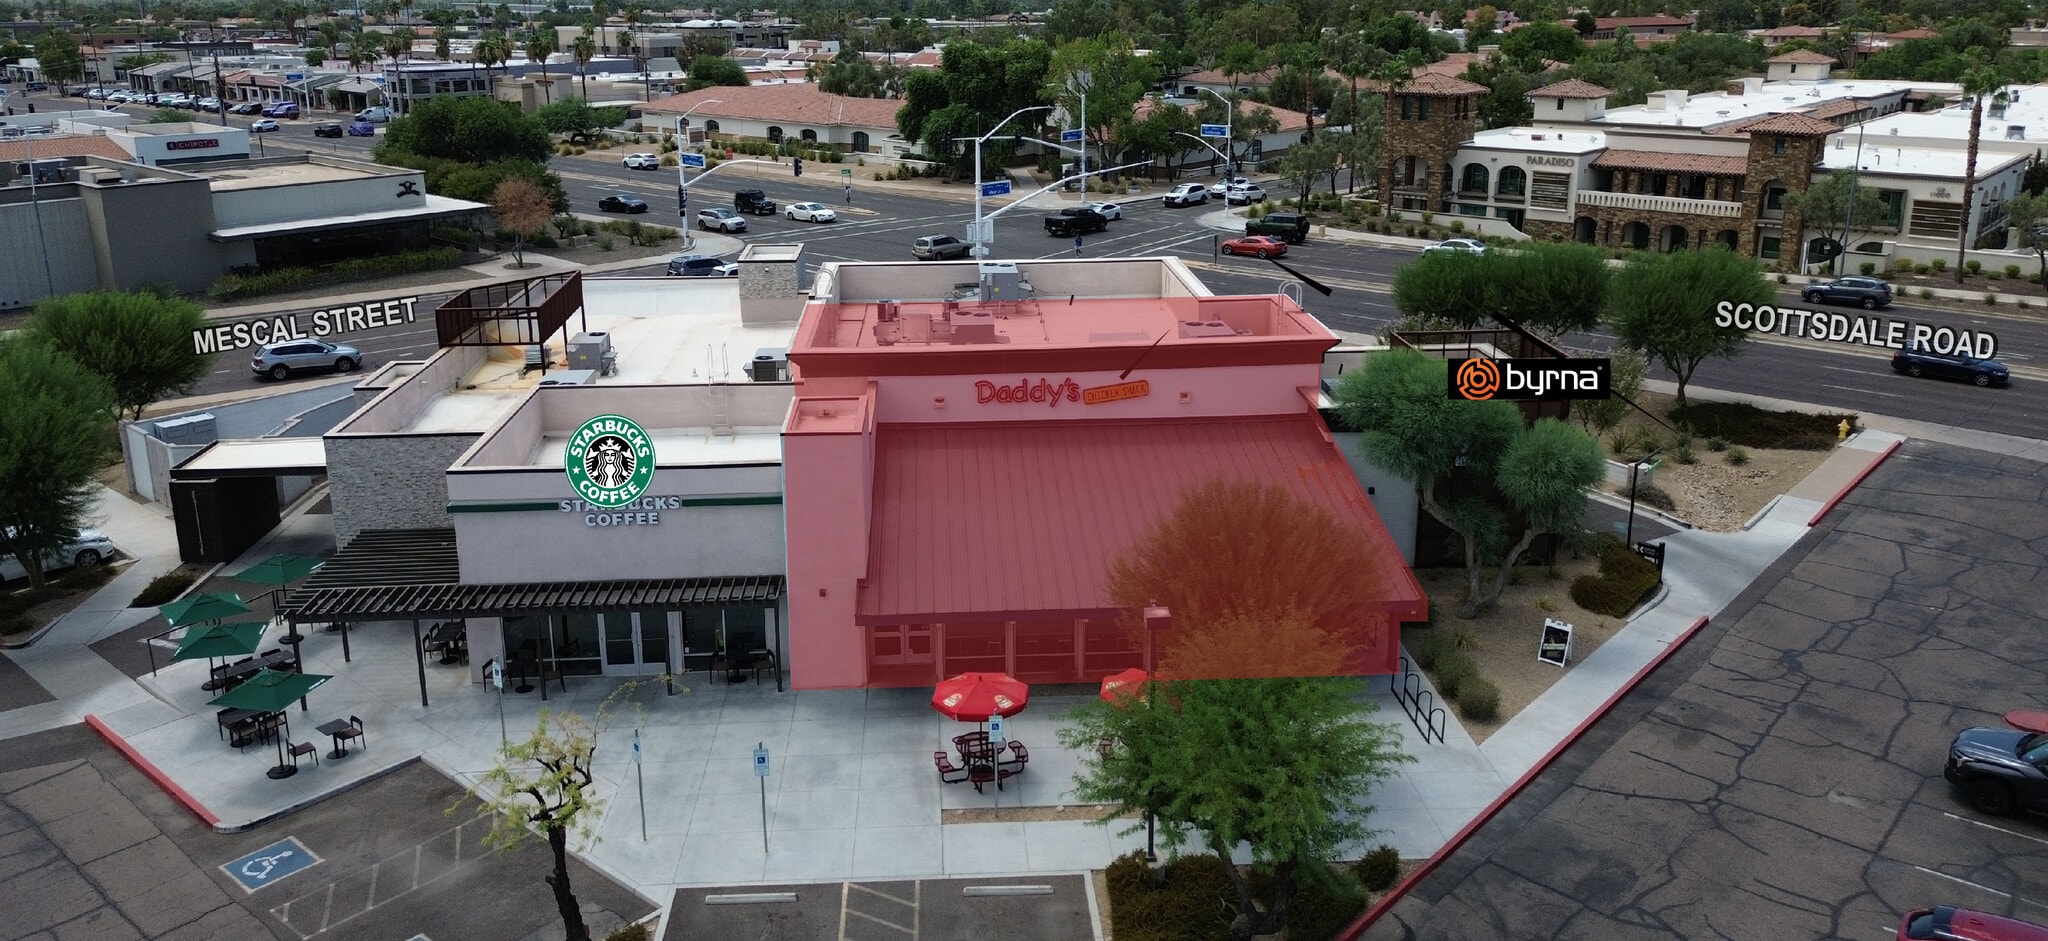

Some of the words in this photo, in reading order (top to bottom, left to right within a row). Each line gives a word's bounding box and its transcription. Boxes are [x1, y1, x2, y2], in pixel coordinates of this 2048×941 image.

[178, 140, 218, 149] CHIPOTLE
[1526, 156, 1575, 167] PARADISO
[975, 377, 1080, 408] Daddy's
[1087, 389, 1120, 402] CHICKEN
[1122, 383, 1147, 397] SHACK
[584, 512, 659, 527] COFFEE
